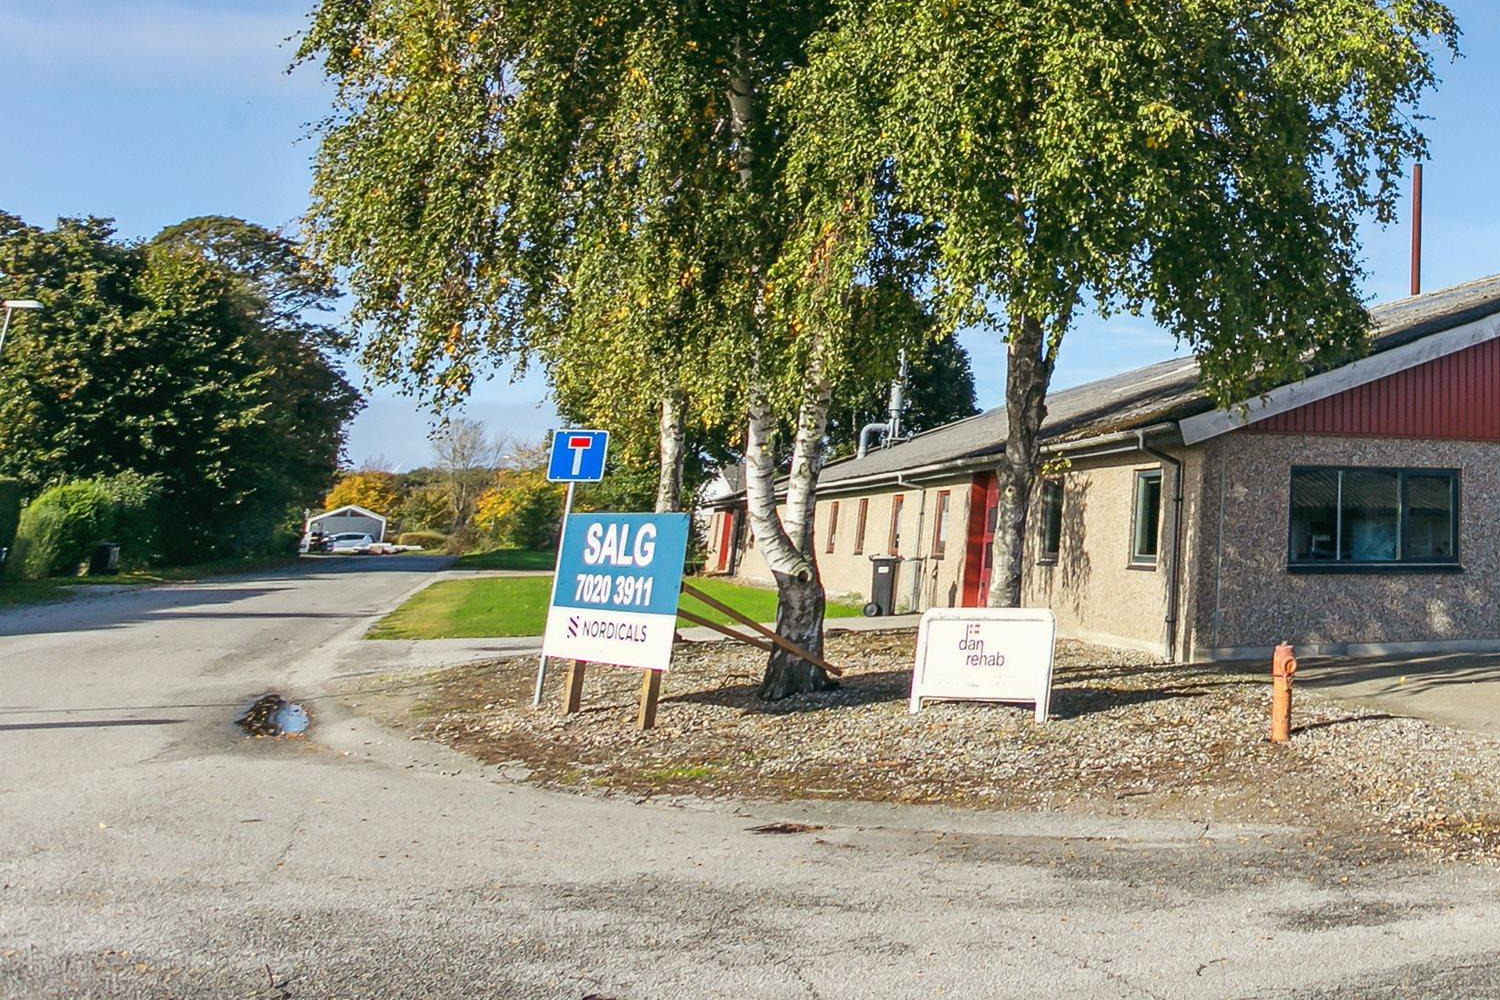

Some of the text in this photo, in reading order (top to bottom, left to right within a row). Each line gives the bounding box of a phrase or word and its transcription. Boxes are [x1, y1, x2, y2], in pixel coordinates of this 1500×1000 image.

[583, 522, 657, 567] SALG
[575, 573, 653, 606] 7020 3911
[582, 620, 648, 643] NORDICALS
[958, 624, 985, 651] dan
[966, 651, 1006, 667] rehab
